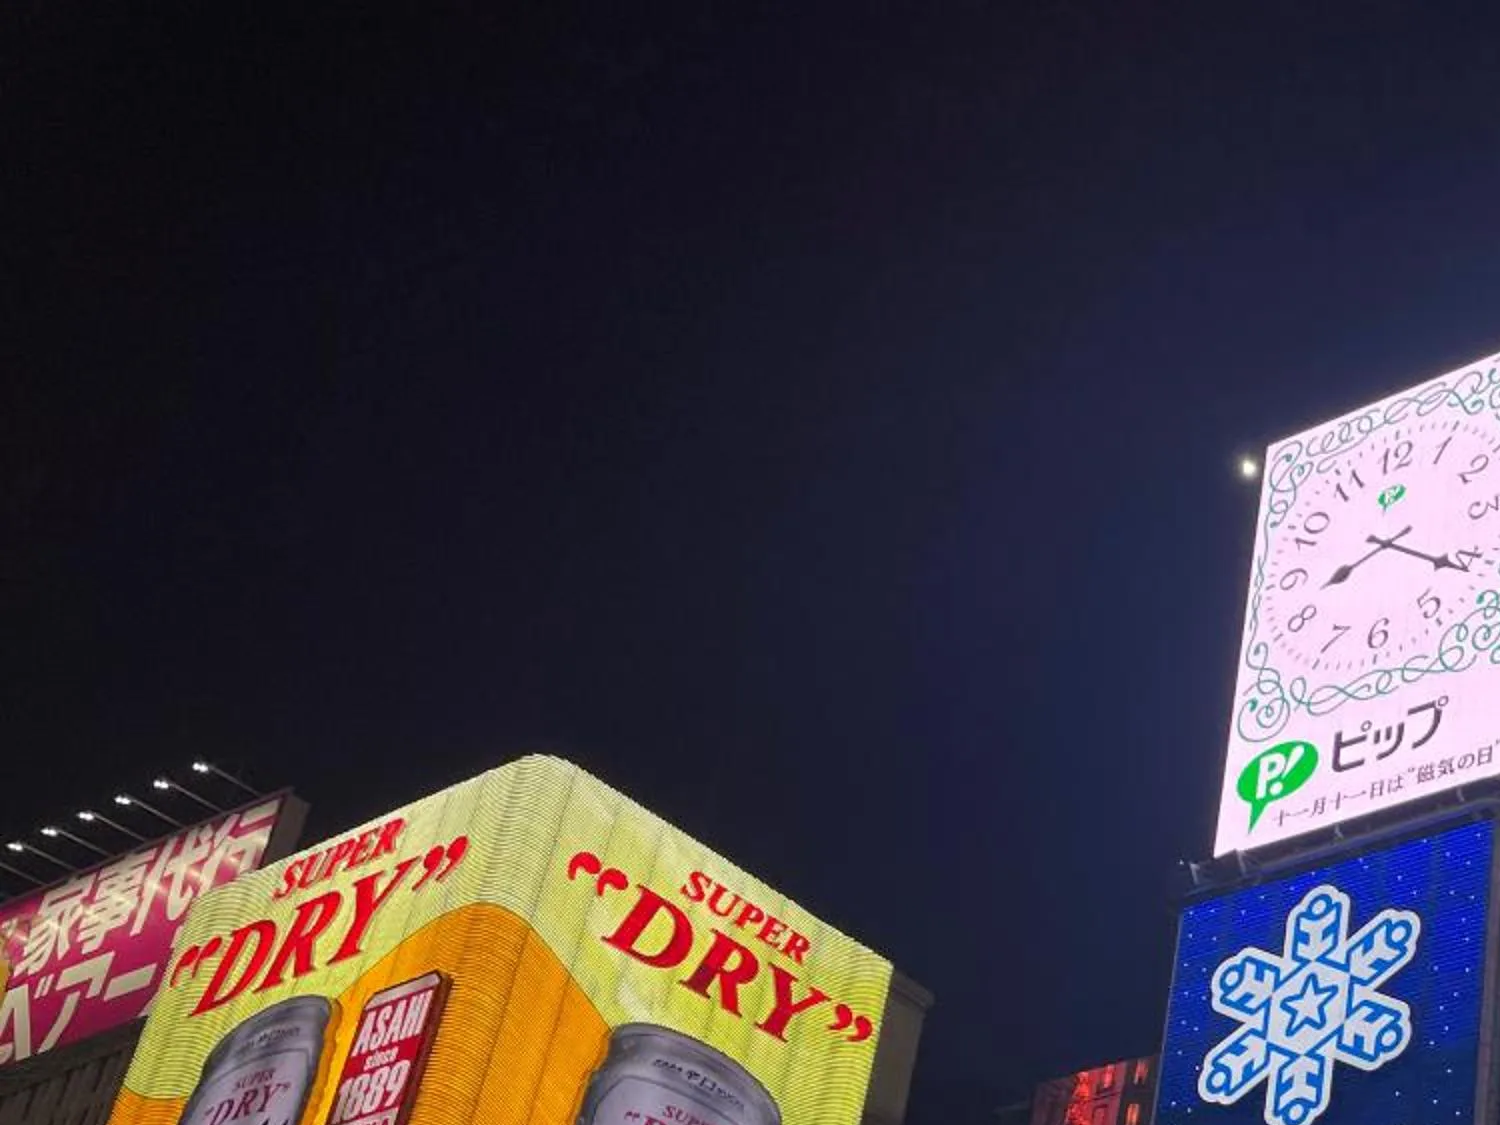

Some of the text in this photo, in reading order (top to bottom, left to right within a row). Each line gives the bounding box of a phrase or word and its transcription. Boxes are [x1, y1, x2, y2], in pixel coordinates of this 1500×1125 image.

[1379, 440, 1412, 474] 12
[1433, 437, 1451, 464] 1
[1458, 454, 1489, 484] 2
[1334, 470, 1364, 502] 11
[1467, 495, 1500, 520] 3
[1294, 511, 1331, 548] 10
[1280, 568, 1308, 590] 9
[1287, 604, 1317, 632] 8
[1417, 587, 1441, 619] 5
[1320, 624, 1351, 653] 7
[1367, 617, 1389, 649] 6
[1331, 695, 1449, 773] ピップ
[273, 817, 406, 900] SUPER
[12, 799, 281, 977] 家事代行
[680, 870, 811, 966] SUPER
[0, 945, 165, 1065] ベアー
[351, 988, 434, 1057] ASAHI
[331, 1059, 411, 1125] 1889
